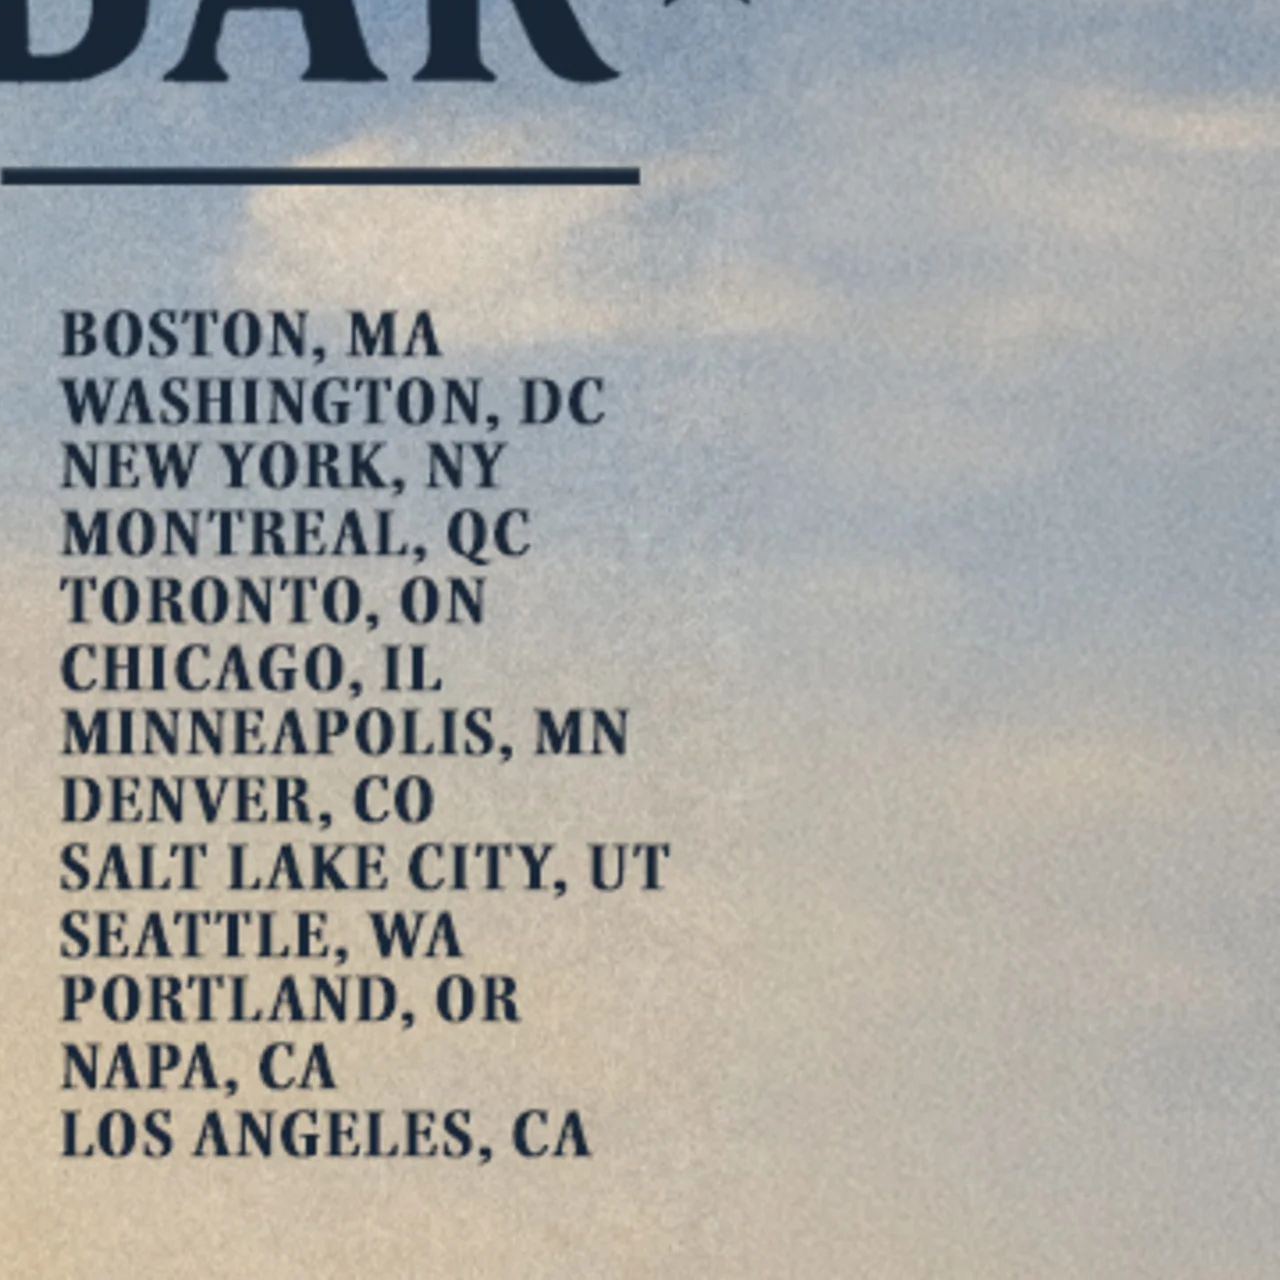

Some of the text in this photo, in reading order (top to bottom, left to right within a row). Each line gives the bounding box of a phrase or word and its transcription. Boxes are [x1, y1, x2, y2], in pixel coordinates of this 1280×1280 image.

[63, 310, 441, 363] BOSTON, MA
[61, 377, 605, 431] WASHINGTON, DC
[62, 441, 504, 495] NEW YORK, NY
[63, 509, 530, 566] MONTREAL, QC
[59, 577, 484, 630] TORONTO, ON
[61, 644, 442, 697] CHICAGO, IL
[63, 708, 627, 761] MINNEAPOLIS, MN
[63, 776, 433, 829] DENVER, CO
[61, 843, 670, 896] SALT LAKE CITY, UT
[61, 911, 461, 964] SEATTLE, WA
[63, 975, 518, 1028] PORTLAND, OR
[63, 1043, 336, 1095] NAPA, CA
[63, 1110, 590, 1163] LOS ANGELES, CA
